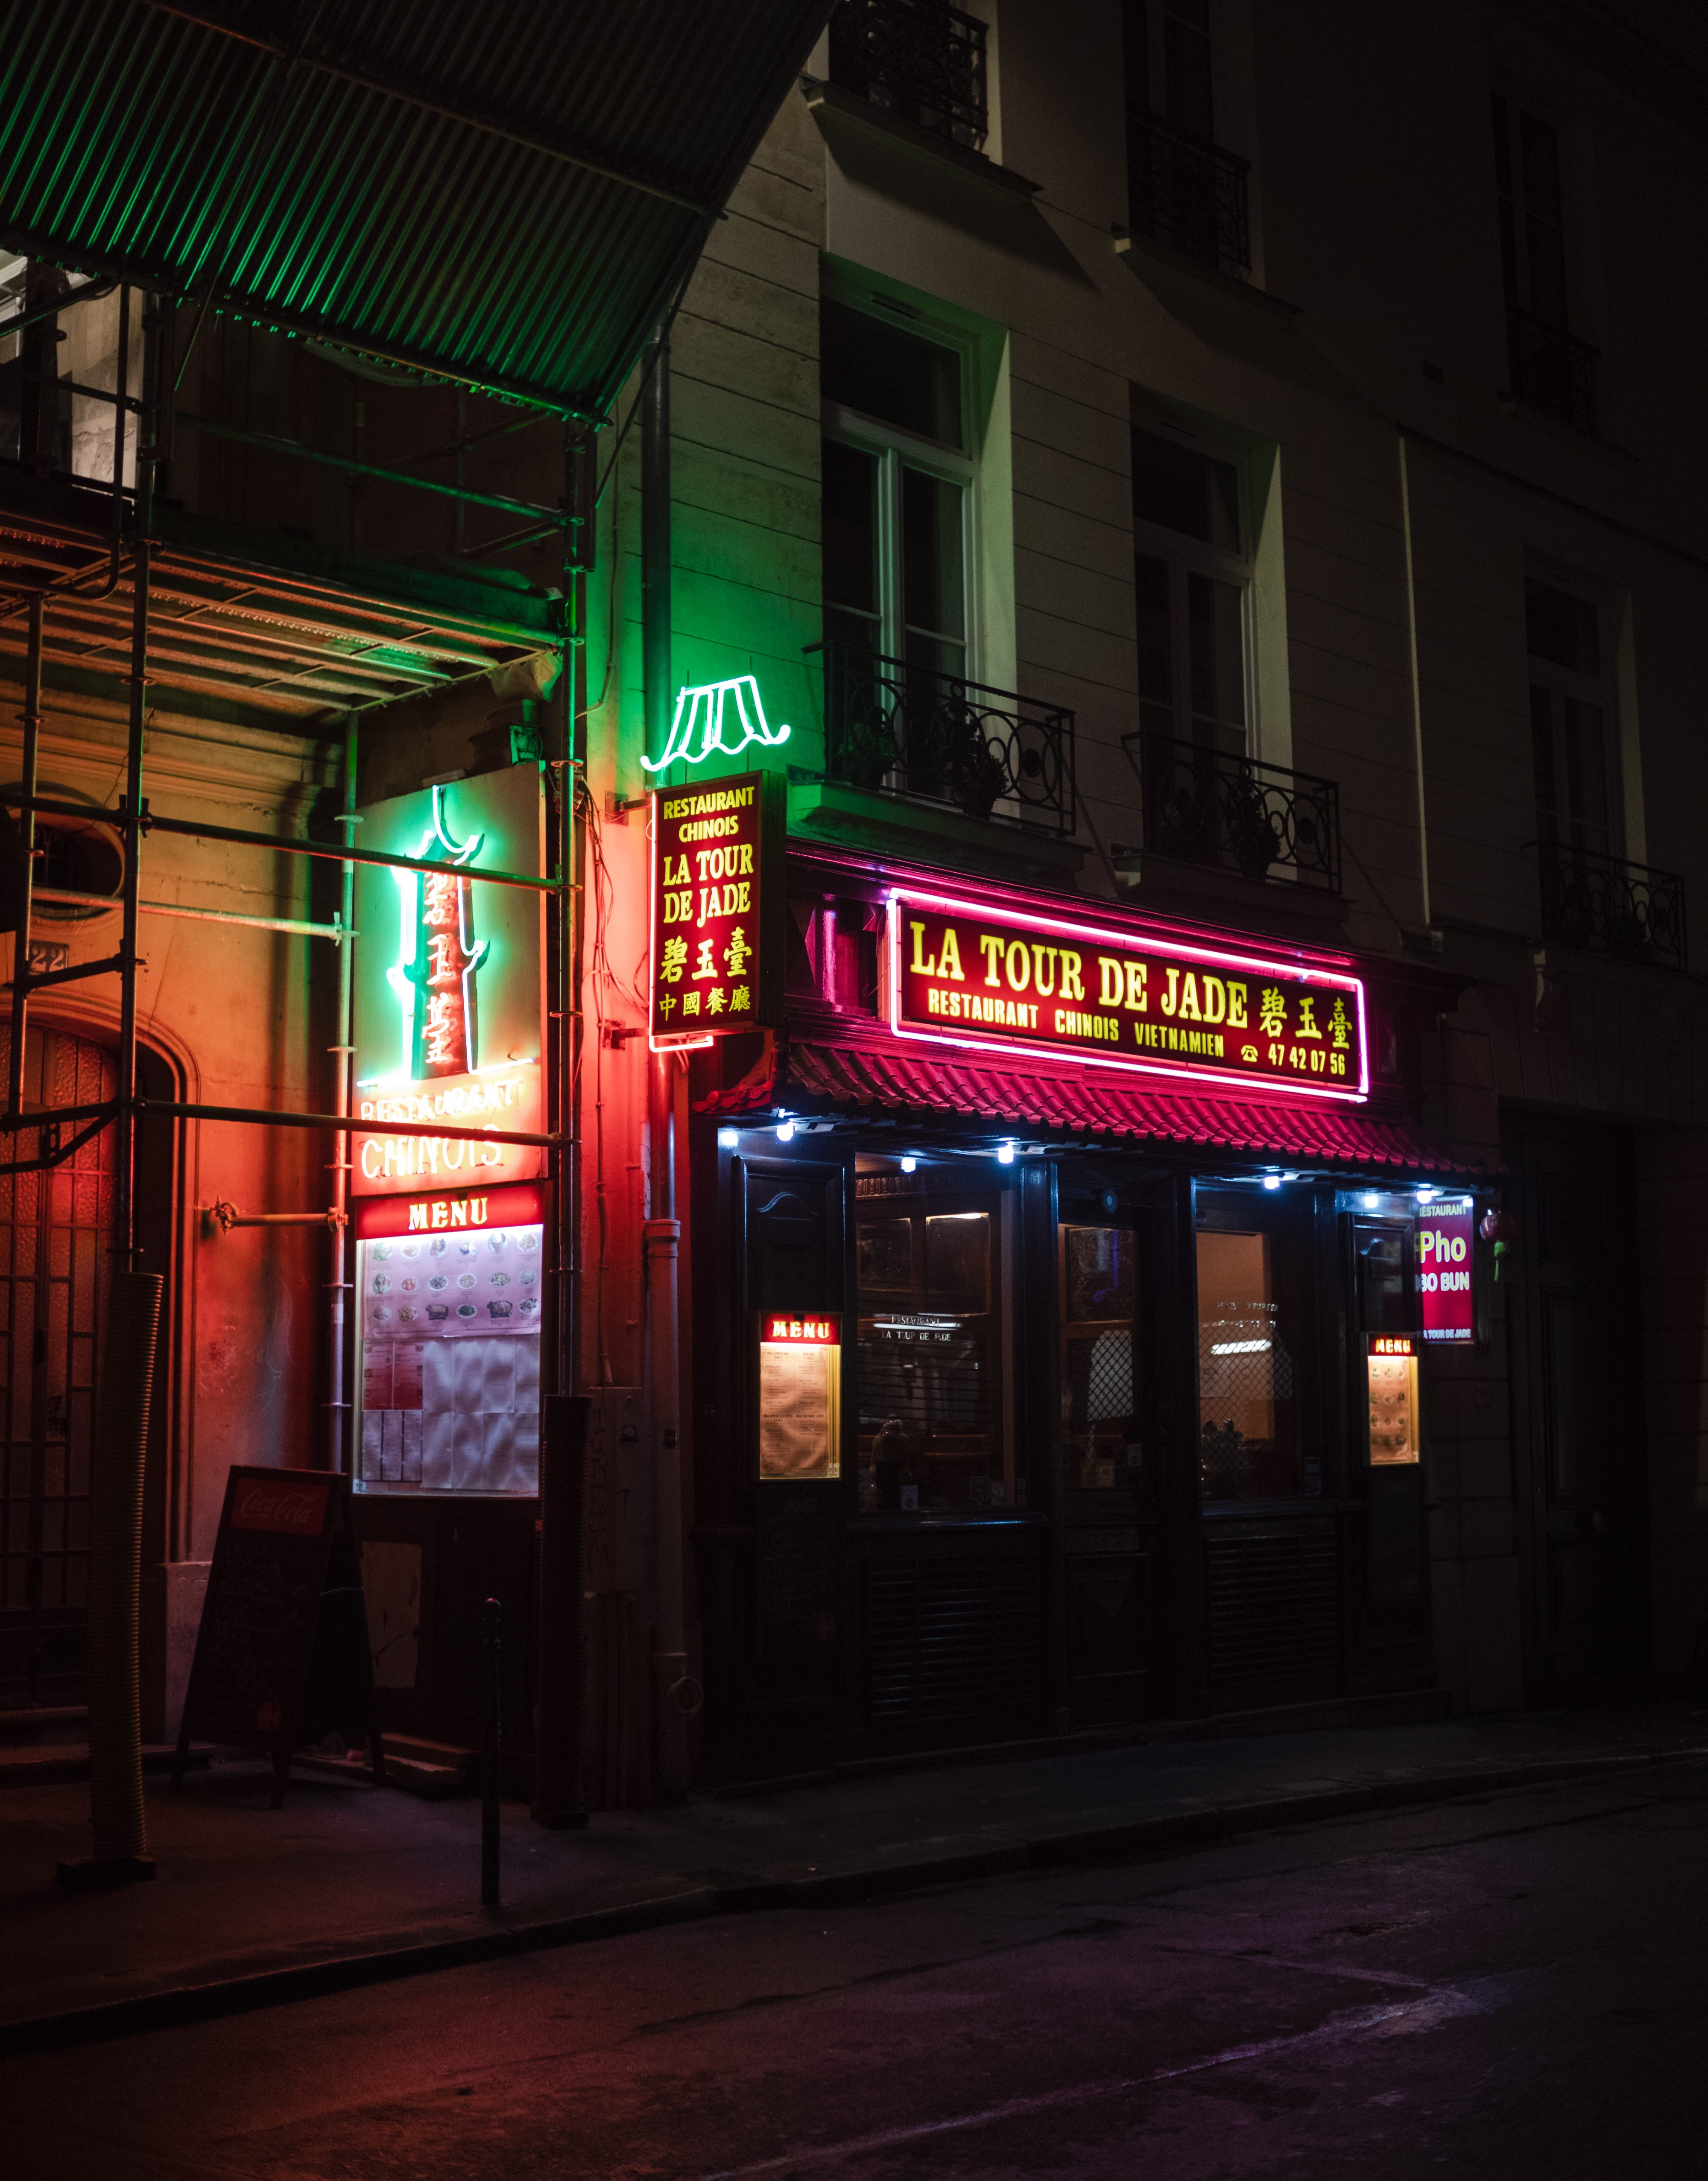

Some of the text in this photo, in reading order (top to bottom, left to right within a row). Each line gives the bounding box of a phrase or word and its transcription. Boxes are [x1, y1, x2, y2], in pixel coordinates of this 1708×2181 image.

[664, 786, 755, 819] RESTAURANT
[679, 815, 739, 843] CHINOIS
[663, 843, 754, 886] LA TOUR
[664, 881, 751, 928] DE JADE
[31, 946, 64, 972] 22
[660, 927, 752, 983] 碧玉臺
[910, 921, 1248, 1029] LA TOUR DE JADE
[659, 985, 750, 1021] 中國餐廳
[1259, 986, 1353, 1050] 碧玉臺
[928, 988, 1345, 1076] RESTAURANT CHINOIS VIETNAMIEN 47 42 07 56
[360, 1079, 518, 1123] RESTAURANT
[361, 1124, 502, 1178] CHINOIS
[408, 1197, 488, 1230] MENU
[1420, 1230, 1466, 1263] Pho
[1440, 1271, 1470, 1291] BUN
[772, 1321, 830, 1339] MENU
[919, 1332, 930, 1341] DE
[1376, 1339, 1411, 1354] MENU
